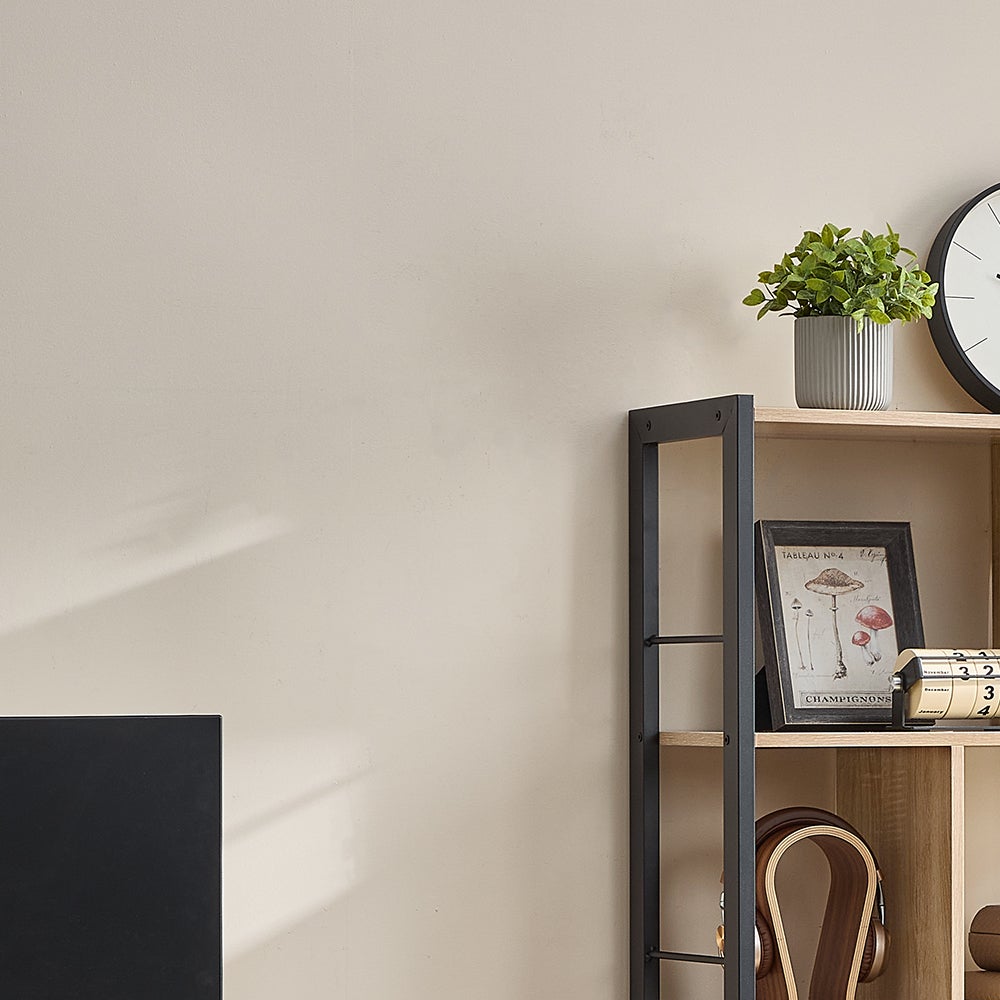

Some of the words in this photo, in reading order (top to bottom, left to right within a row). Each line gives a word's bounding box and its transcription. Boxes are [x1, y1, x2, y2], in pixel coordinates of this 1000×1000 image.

[782, 551, 820, 560] TABLEAU
[958, 666, 970, 681] 3
[983, 665, 996, 679] 2
[983, 685, 995, 700] 3
[805, 695, 891, 703] CHAMPIGNONS
[976, 705, 991, 716] 4
